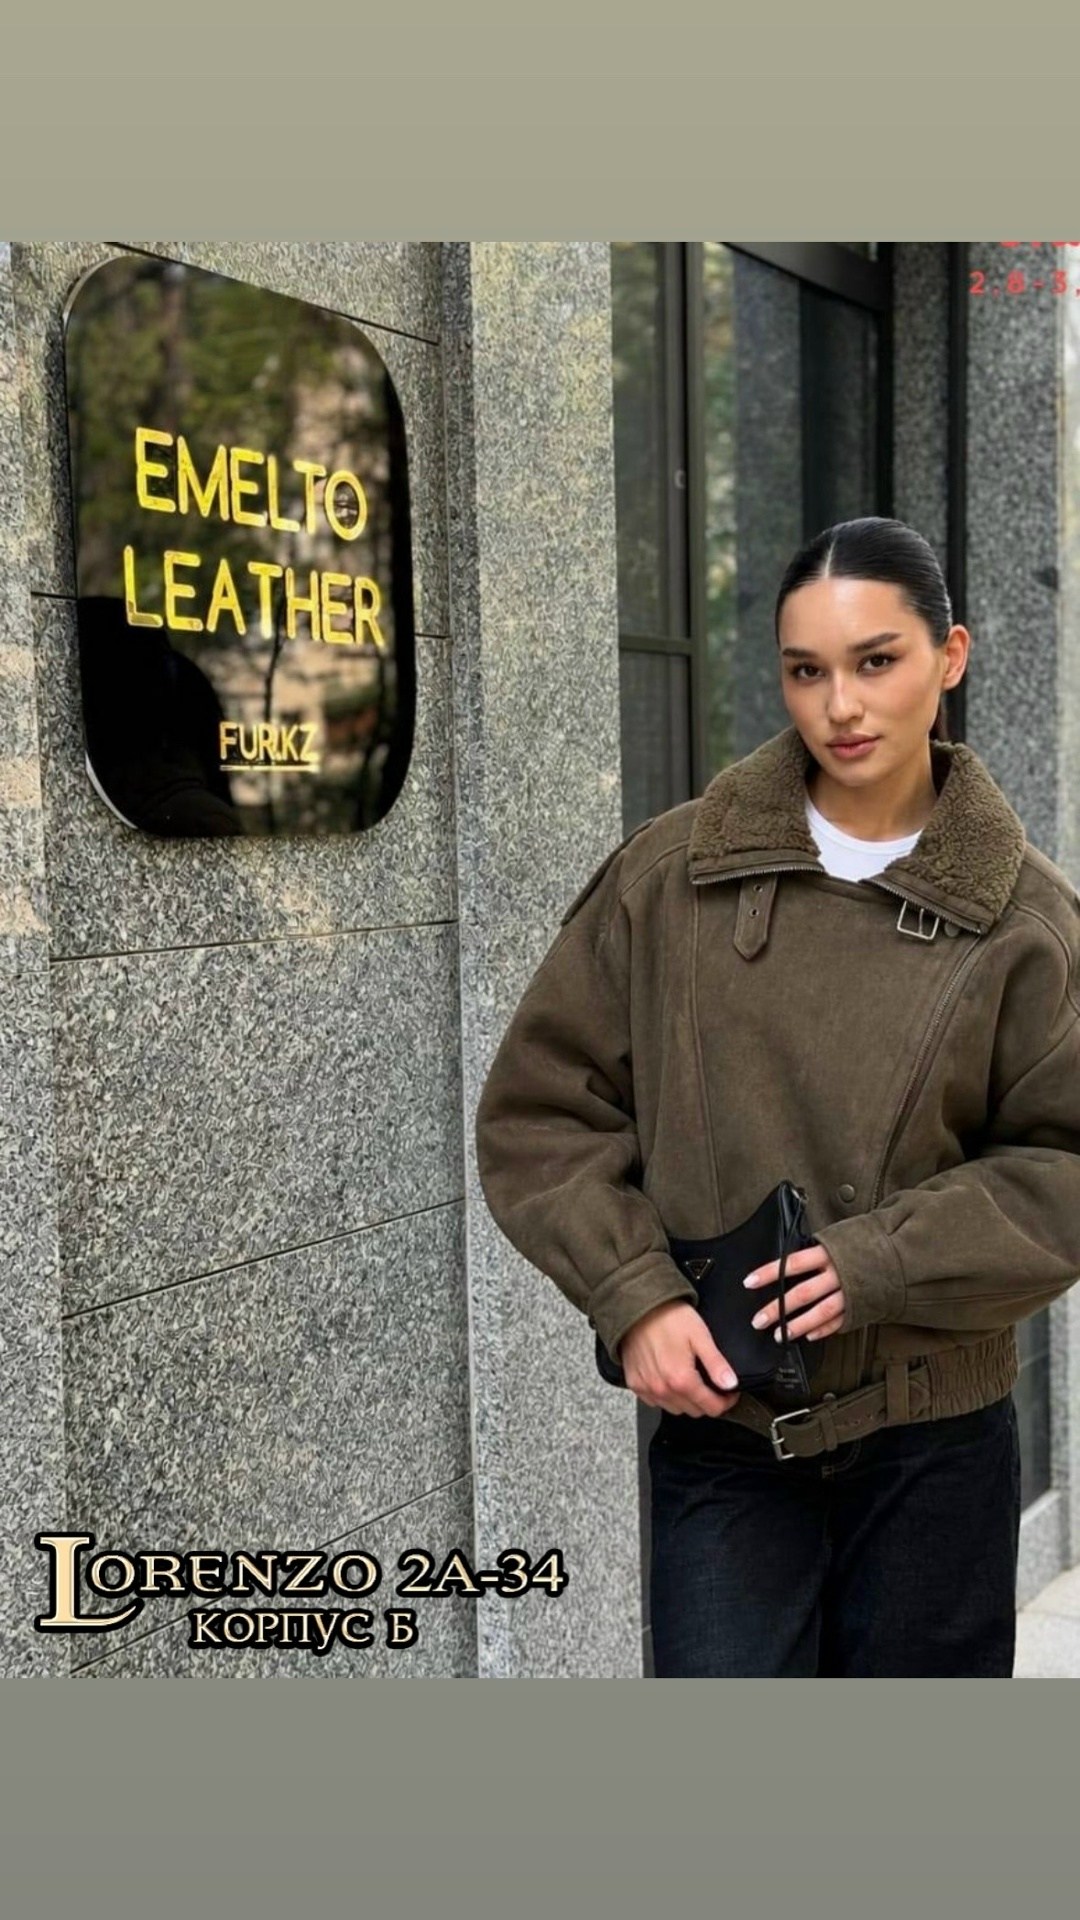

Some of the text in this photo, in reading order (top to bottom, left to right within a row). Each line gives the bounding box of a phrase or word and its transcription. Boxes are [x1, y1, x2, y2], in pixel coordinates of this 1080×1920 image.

[135, 426, 368, 541] EMELTO
[123, 544, 386, 648] LEATHER
[219, 721, 319, 762] FUR.KZ
